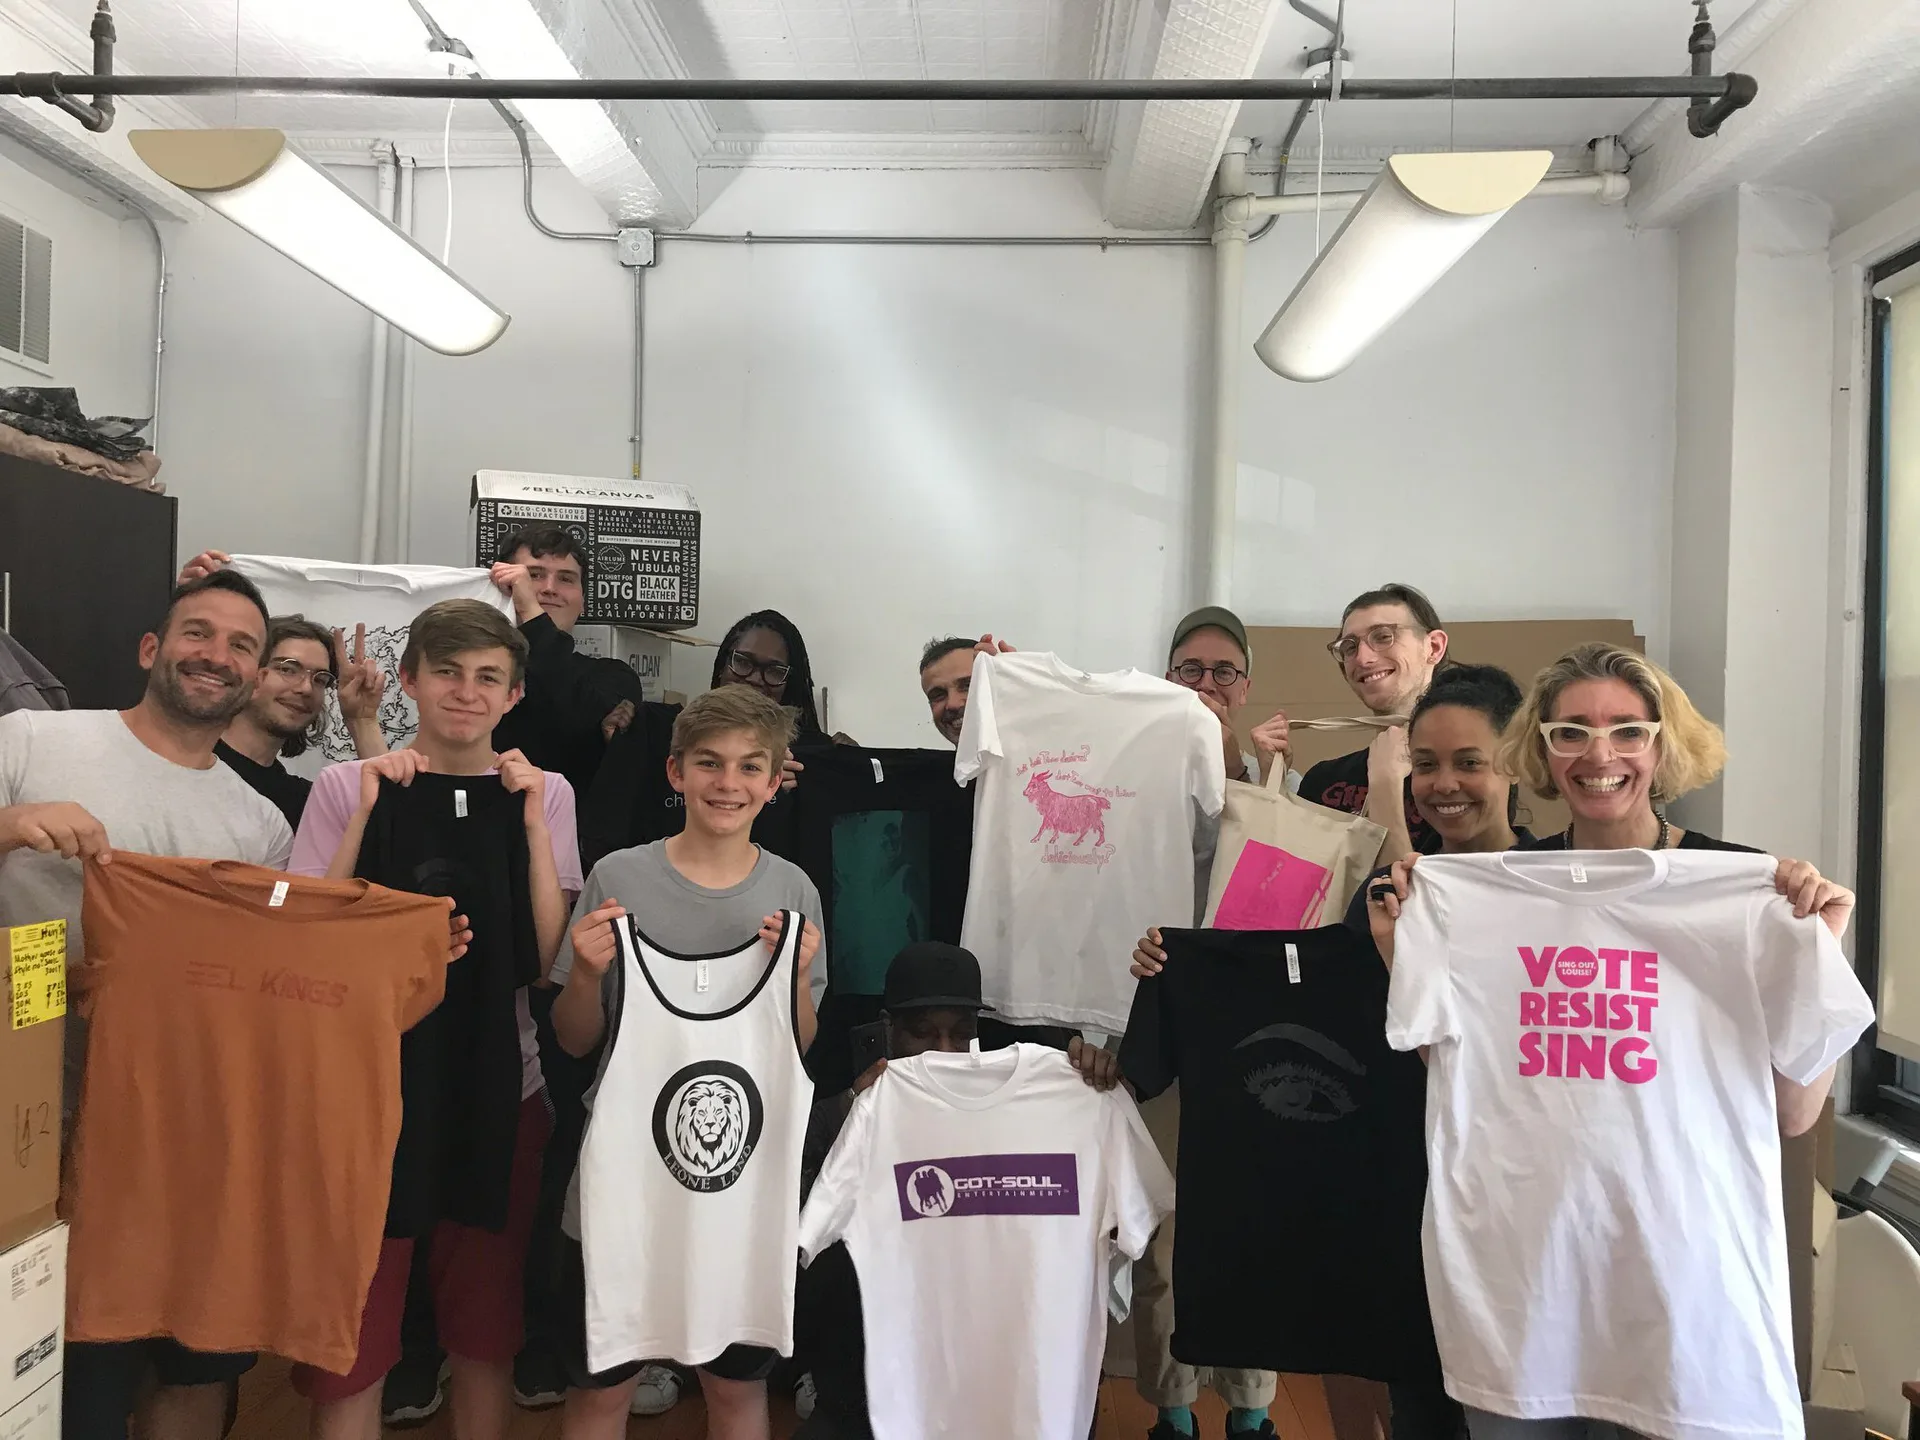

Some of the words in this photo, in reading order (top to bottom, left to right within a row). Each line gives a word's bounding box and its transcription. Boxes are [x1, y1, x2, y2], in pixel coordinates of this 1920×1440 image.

[522, 486, 655, 499] #BELLACANVAS
[514, 505, 585, 515] ECO-CONSCIOUS
[514, 511, 585, 520] MANUFACTURING
[642, 511, 694, 520] TRIBLEND
[487, 525, 495, 553] EVERY
[630, 548, 680, 563] NEVER
[630, 562, 681, 573] TUBULAR
[640, 576, 676, 590] BLACK
[597, 581, 633, 600] DTG
[640, 590, 676, 600] HEATHER
[597, 602, 619, 610] LOS
[627, 604, 680, 612] ANGELES
[597, 610, 680, 620] CALIFORNIA
[629, 653, 660, 677] GILDAN
[1517, 945, 1659, 993] VOTE
[1558, 961, 1576, 969] SING
[1562, 968, 1592, 976] LOUISE!
[1519, 992, 1659, 1033] RESIST
[1518, 1031, 1658, 1085] SING
[664, 1151, 711, 1190] LEONE
[720, 1144, 752, 1188] LAND
[953, 1175, 1062, 1190] GOT-SOUL
[957, 1190, 1062, 1198] ENTERTAINMENT
